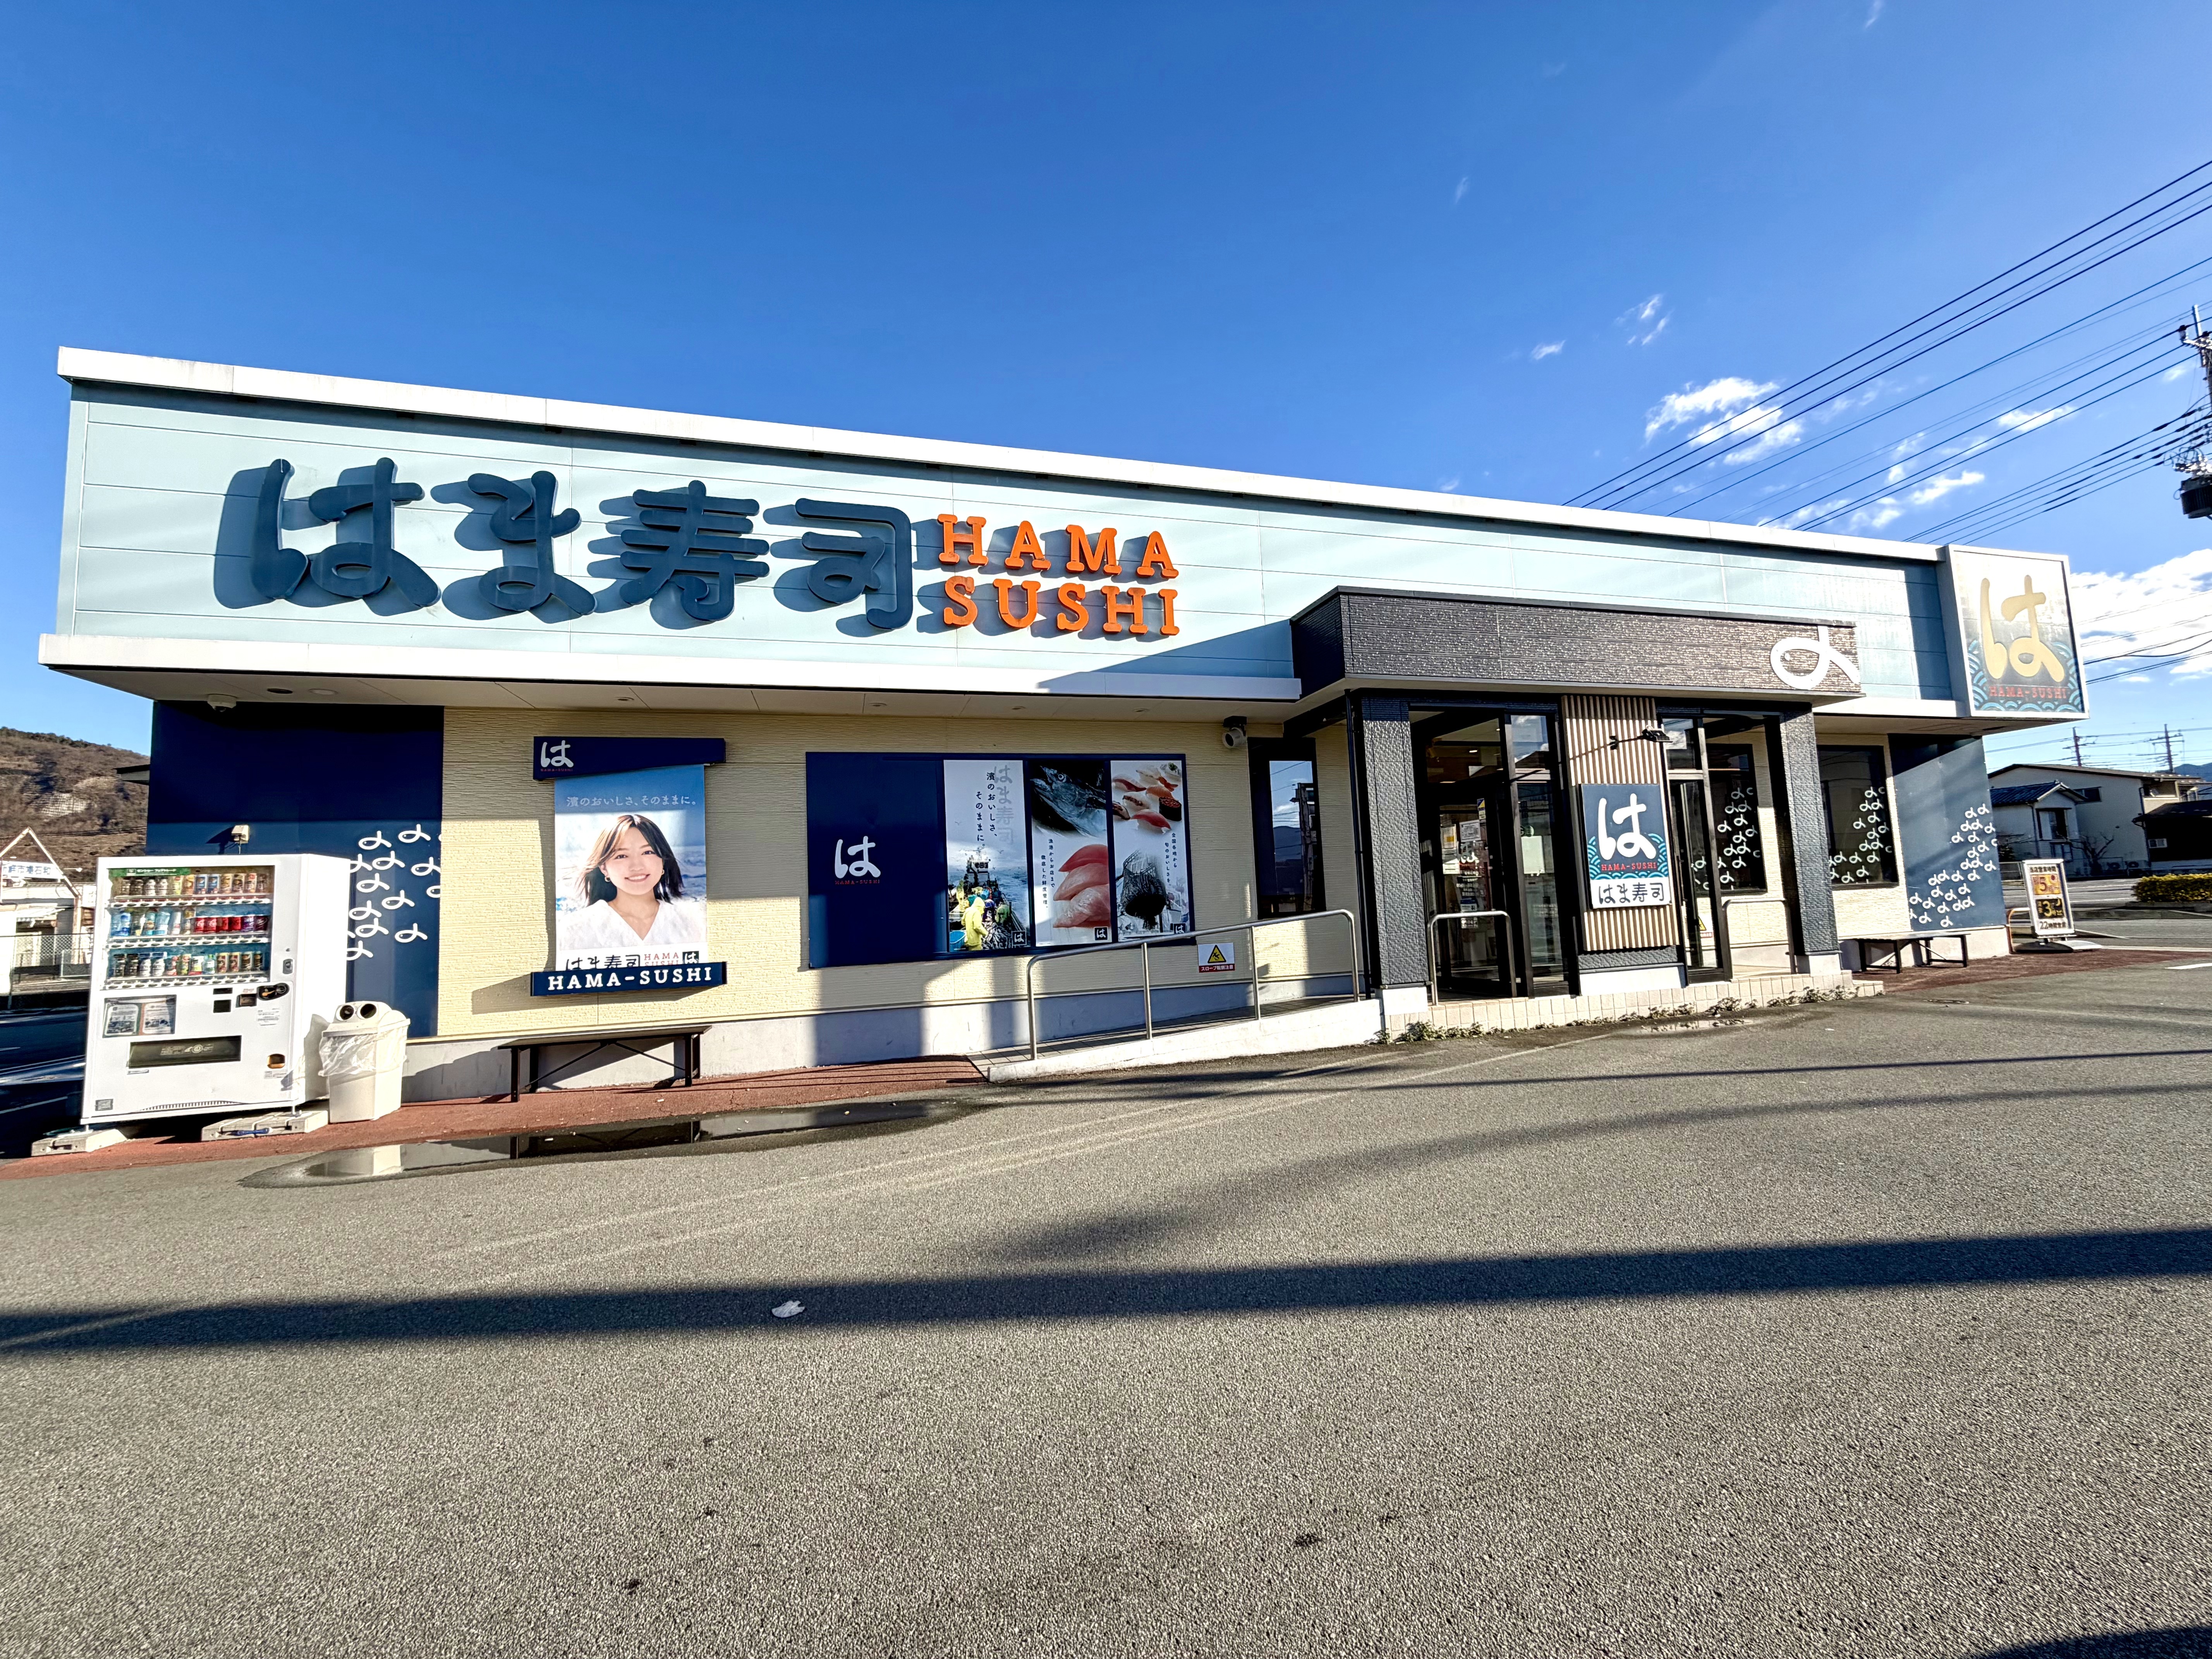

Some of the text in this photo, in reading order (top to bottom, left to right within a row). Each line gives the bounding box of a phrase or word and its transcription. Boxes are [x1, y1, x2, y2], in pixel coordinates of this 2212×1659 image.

[249, 457, 913, 630] はま寿司
[938, 514, 1178, 578] HAMA
[943, 575, 1180, 636] SUSHI
[1980, 575, 2065, 682] は
[1989, 686, 2067, 699] HAMA-SUSHI
[541, 740, 574, 768] は
[976, 792, 985, 847] そのままに。
[986, 772, 997, 836] 濱のおいしさ、
[994, 765, 1014, 845] はま寿司
[1598, 793, 1656, 860] は
[835, 836, 881, 879] は
[1601, 862, 1657, 871] HAMA-SUSHI
[1599, 882, 1664, 905] はま寿司
[1014, 933, 1024, 943] は
[1097, 929, 1106, 938] は
[644, 952, 679, 960] HAMA
[684, 952, 698, 964] は
[548, 967, 712, 991] HAMA-SUSHI
